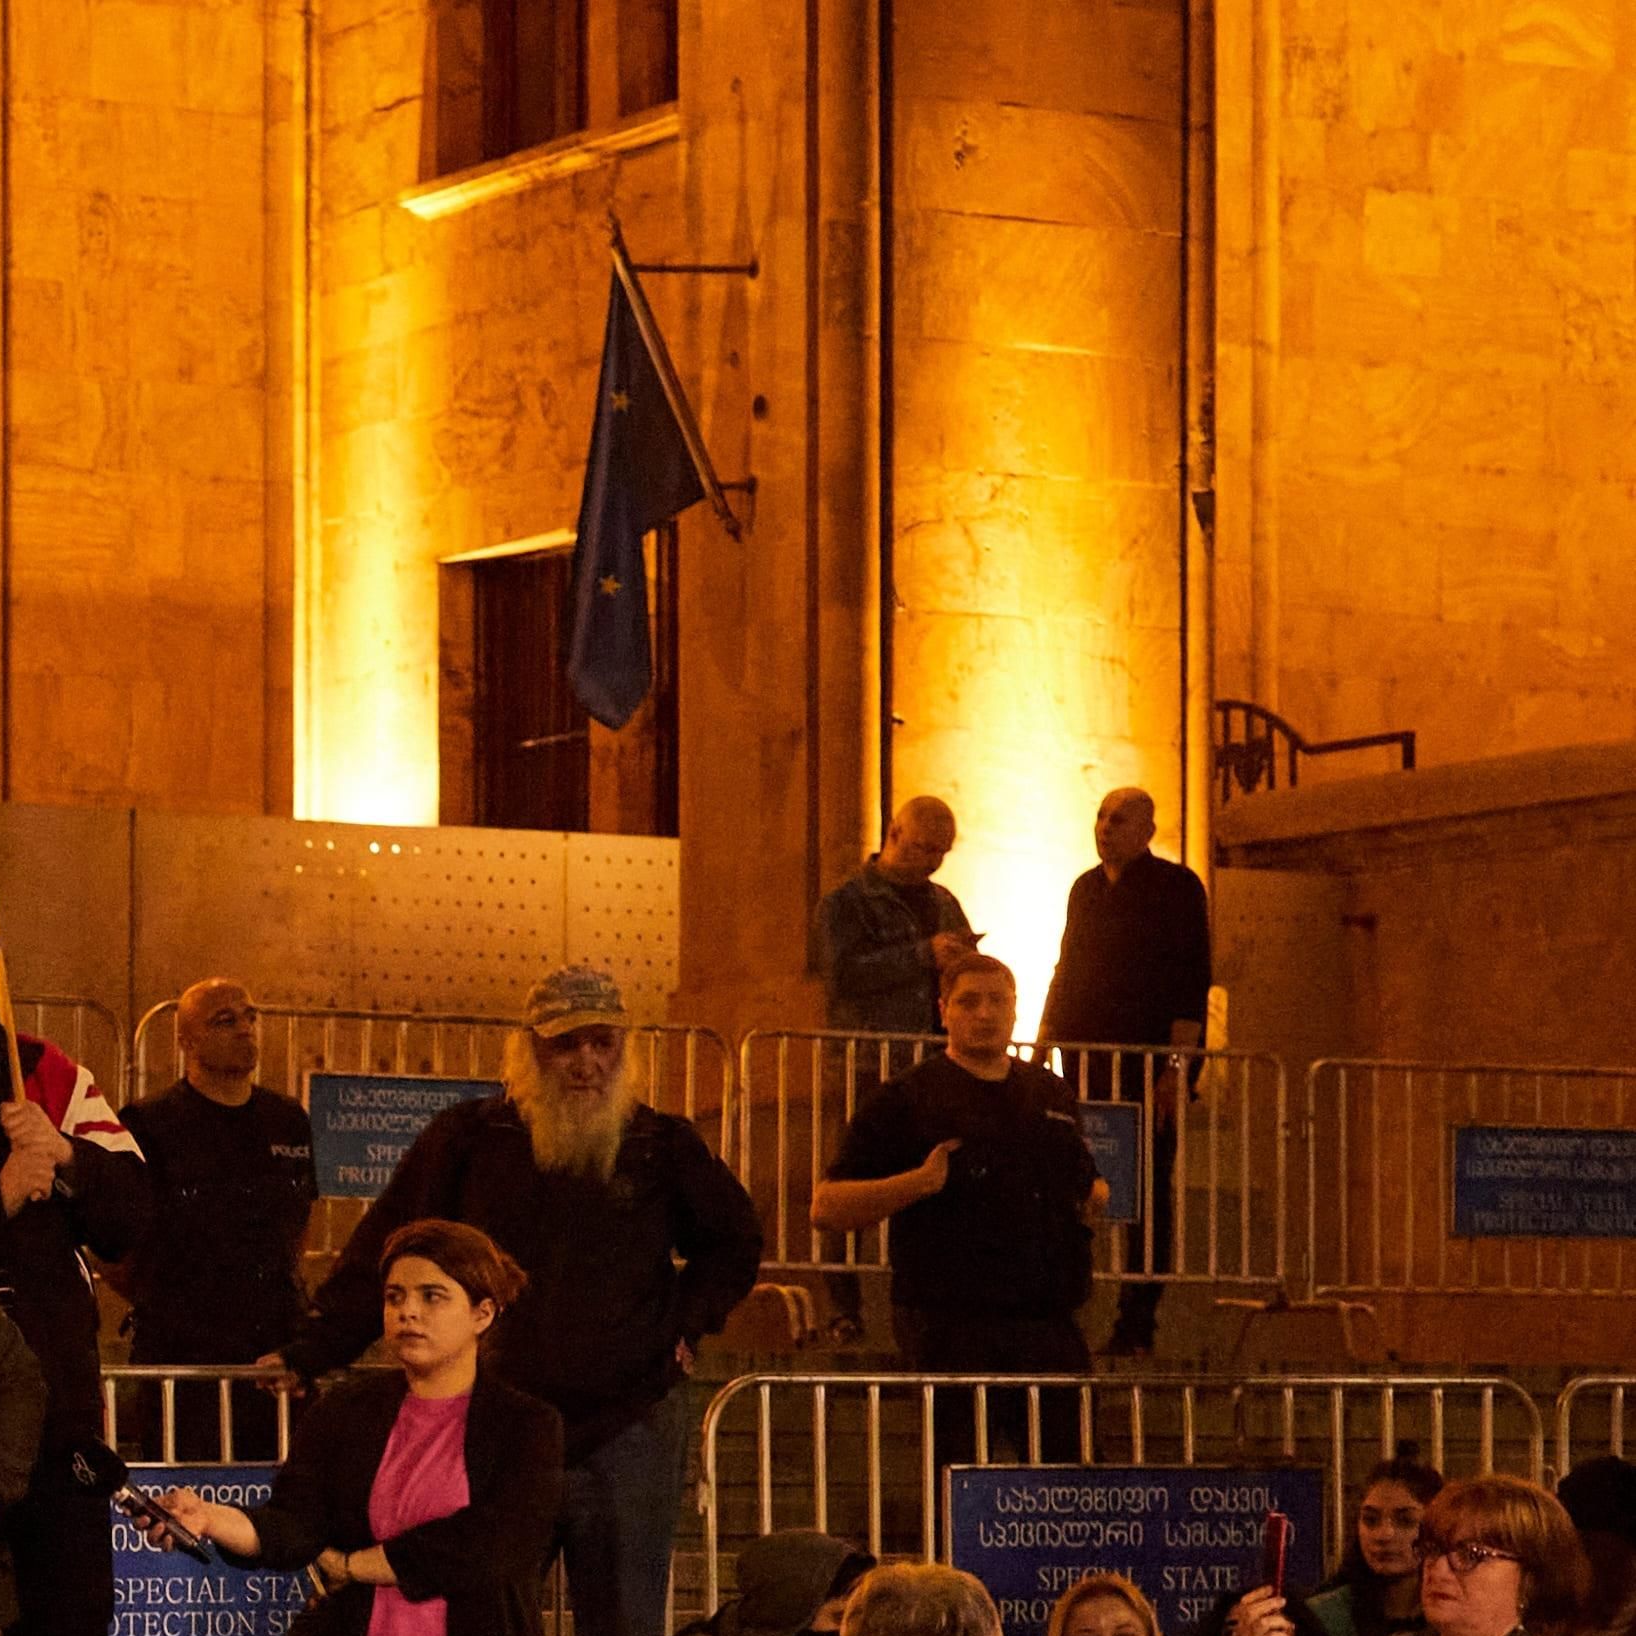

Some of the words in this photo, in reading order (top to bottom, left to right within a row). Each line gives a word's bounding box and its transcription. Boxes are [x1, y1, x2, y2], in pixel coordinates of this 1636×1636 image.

[996, 1486, 1170, 1514] სახელმწიფო
[1189, 1486, 1279, 1514] დაცვის
[978, 1520, 1145, 1548] სპეციალური
[114, 1576, 236, 1605] SPECIAL
[245, 1576, 307, 1602] STA
[1161, 1565, 1241, 1591] STATE
